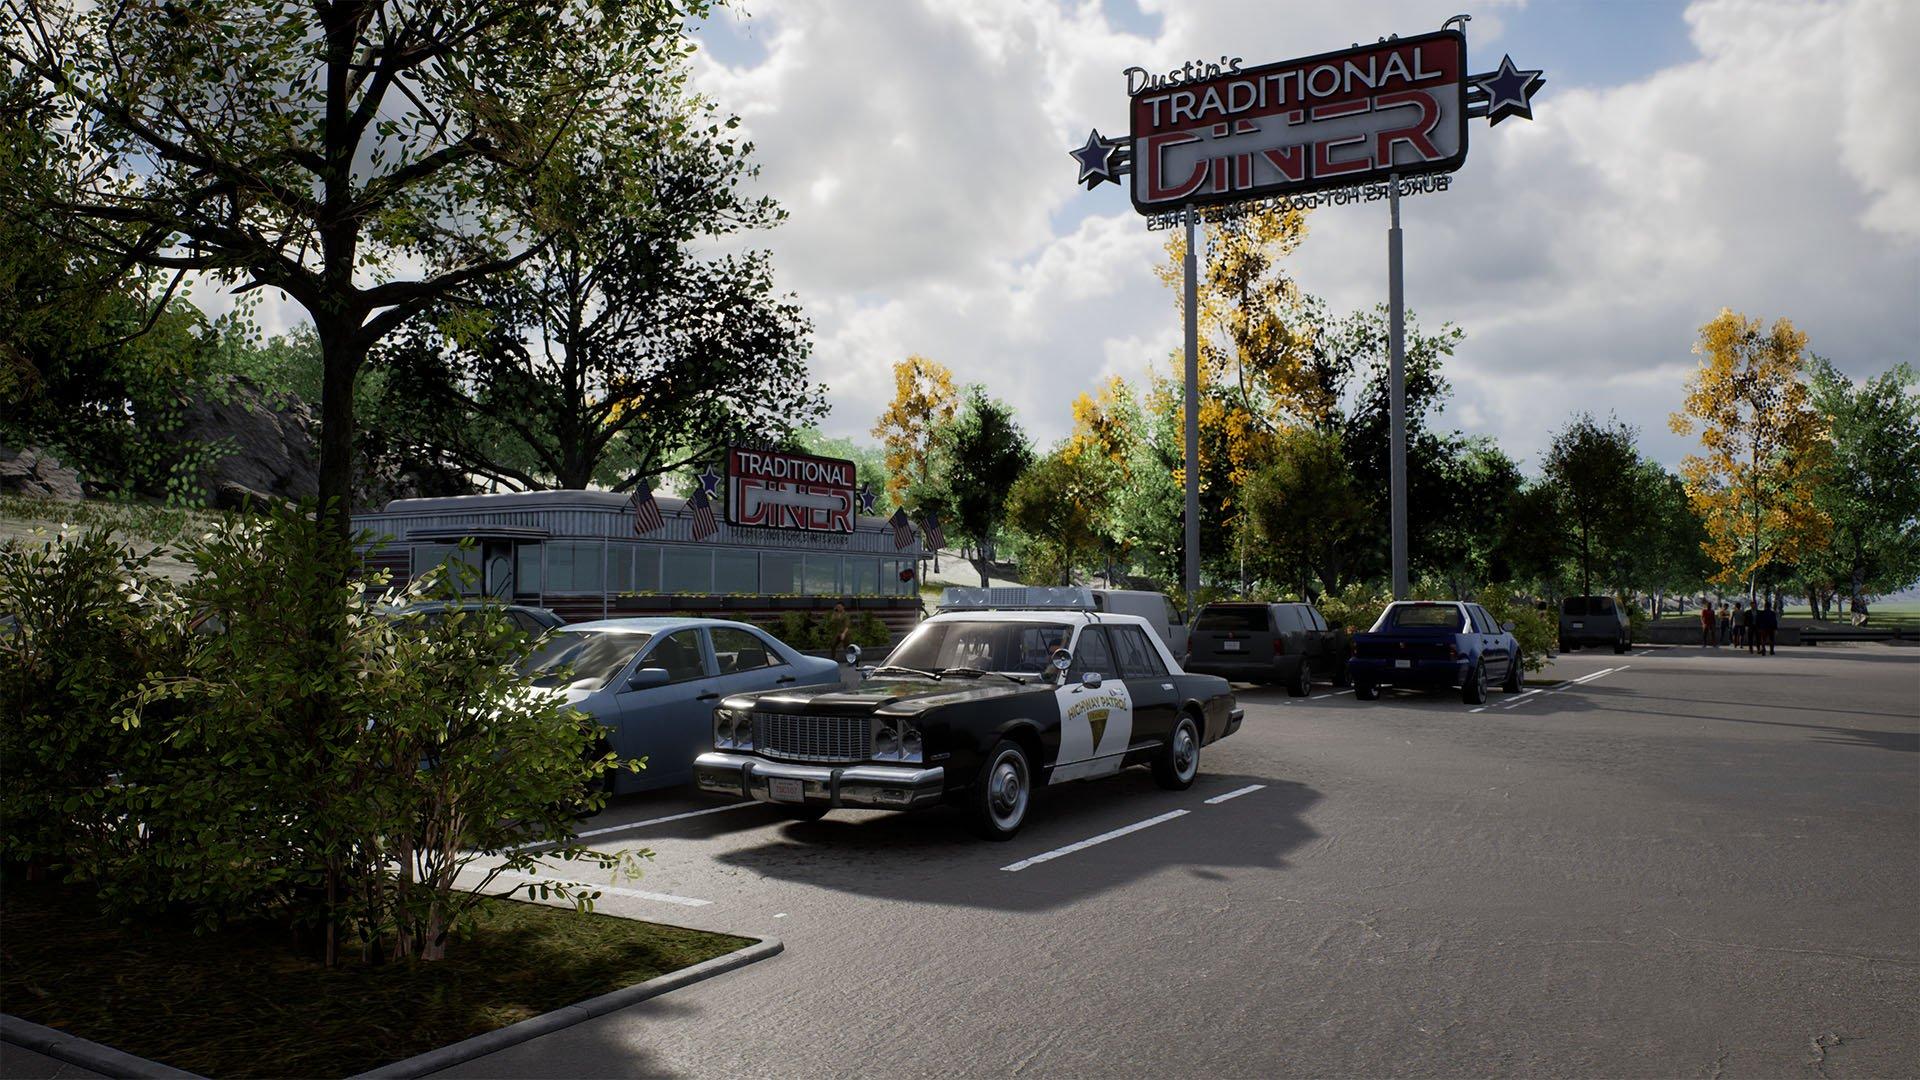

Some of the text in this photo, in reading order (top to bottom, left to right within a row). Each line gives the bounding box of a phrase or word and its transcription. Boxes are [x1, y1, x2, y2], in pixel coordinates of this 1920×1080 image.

[1122, 55, 1243, 97] Dustin's
[1142, 47, 1443, 127] TRADITIONAL
[1147, 88, 1446, 203] DINER
[737, 451, 852, 487] TRADITIONAL
[739, 479, 855, 533] DINER
[1067, 697, 1101, 720] HIGHWAY
[1100, 696, 1128, 712] PATROL
